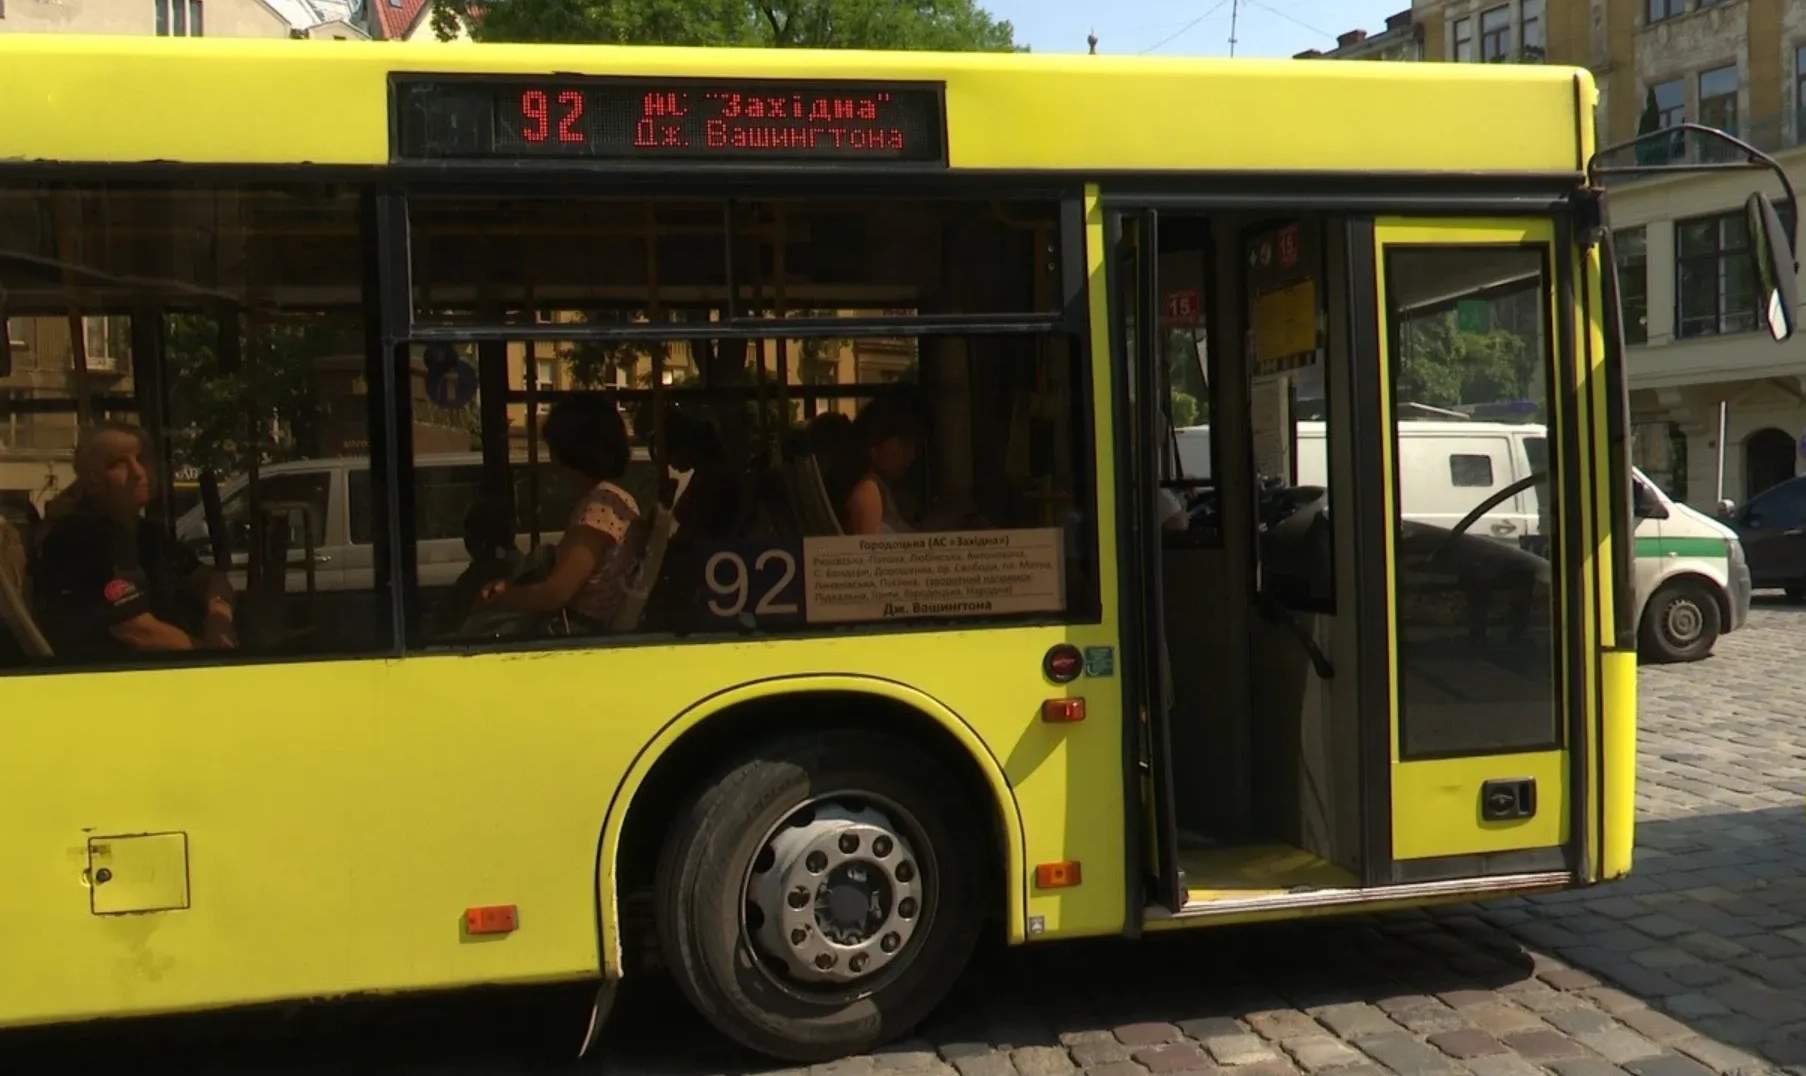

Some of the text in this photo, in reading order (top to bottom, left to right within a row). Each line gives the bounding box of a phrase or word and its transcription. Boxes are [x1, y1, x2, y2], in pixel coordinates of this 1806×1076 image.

[521, 90, 585, 143] 92
[705, 92, 891, 121] "Західна"
[634, 117, 905, 149] Дж. Вашингтона
[928, 536, 947, 549] (АС
[704, 549, 798, 616] 92
[912, 600, 993, 614] Вашингтона
